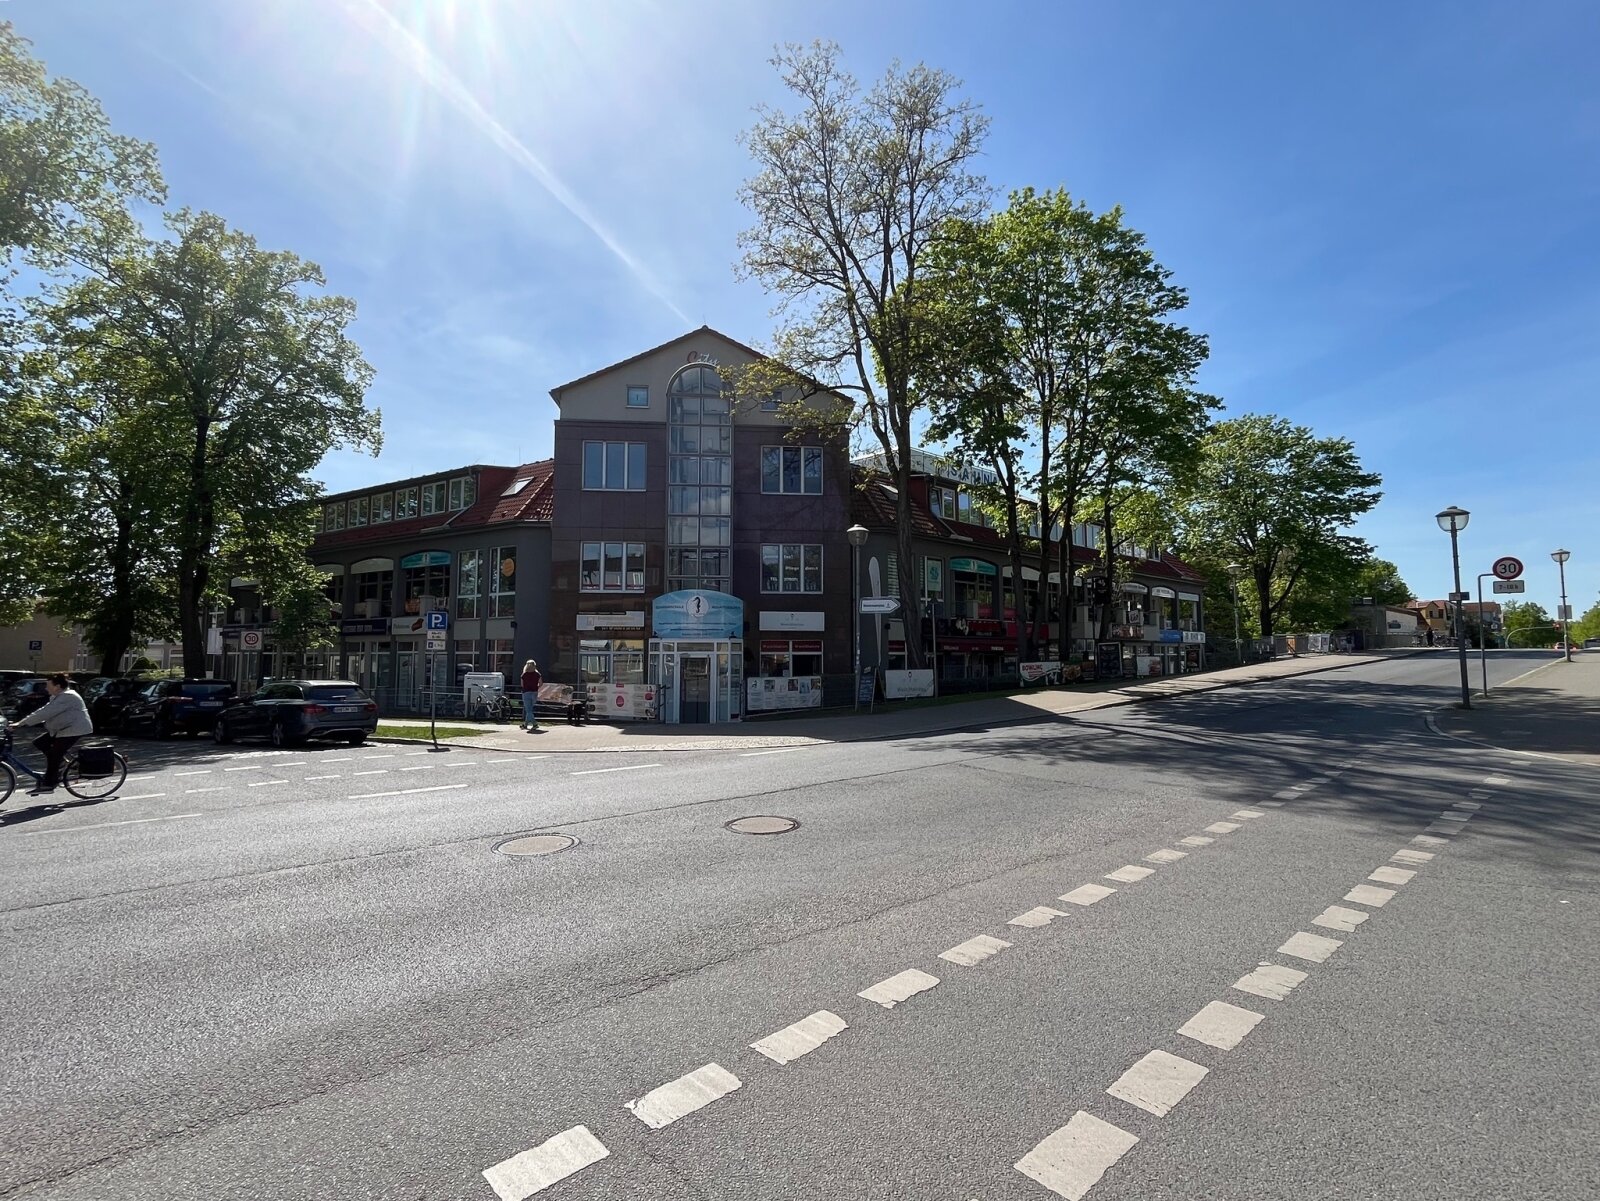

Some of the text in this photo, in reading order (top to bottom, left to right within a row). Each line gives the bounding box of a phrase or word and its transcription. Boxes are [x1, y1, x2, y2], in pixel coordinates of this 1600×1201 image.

[1499, 563, 1516, 574] 30
[432, 614, 443, 628] P
[247, 635, 256, 643] 30
